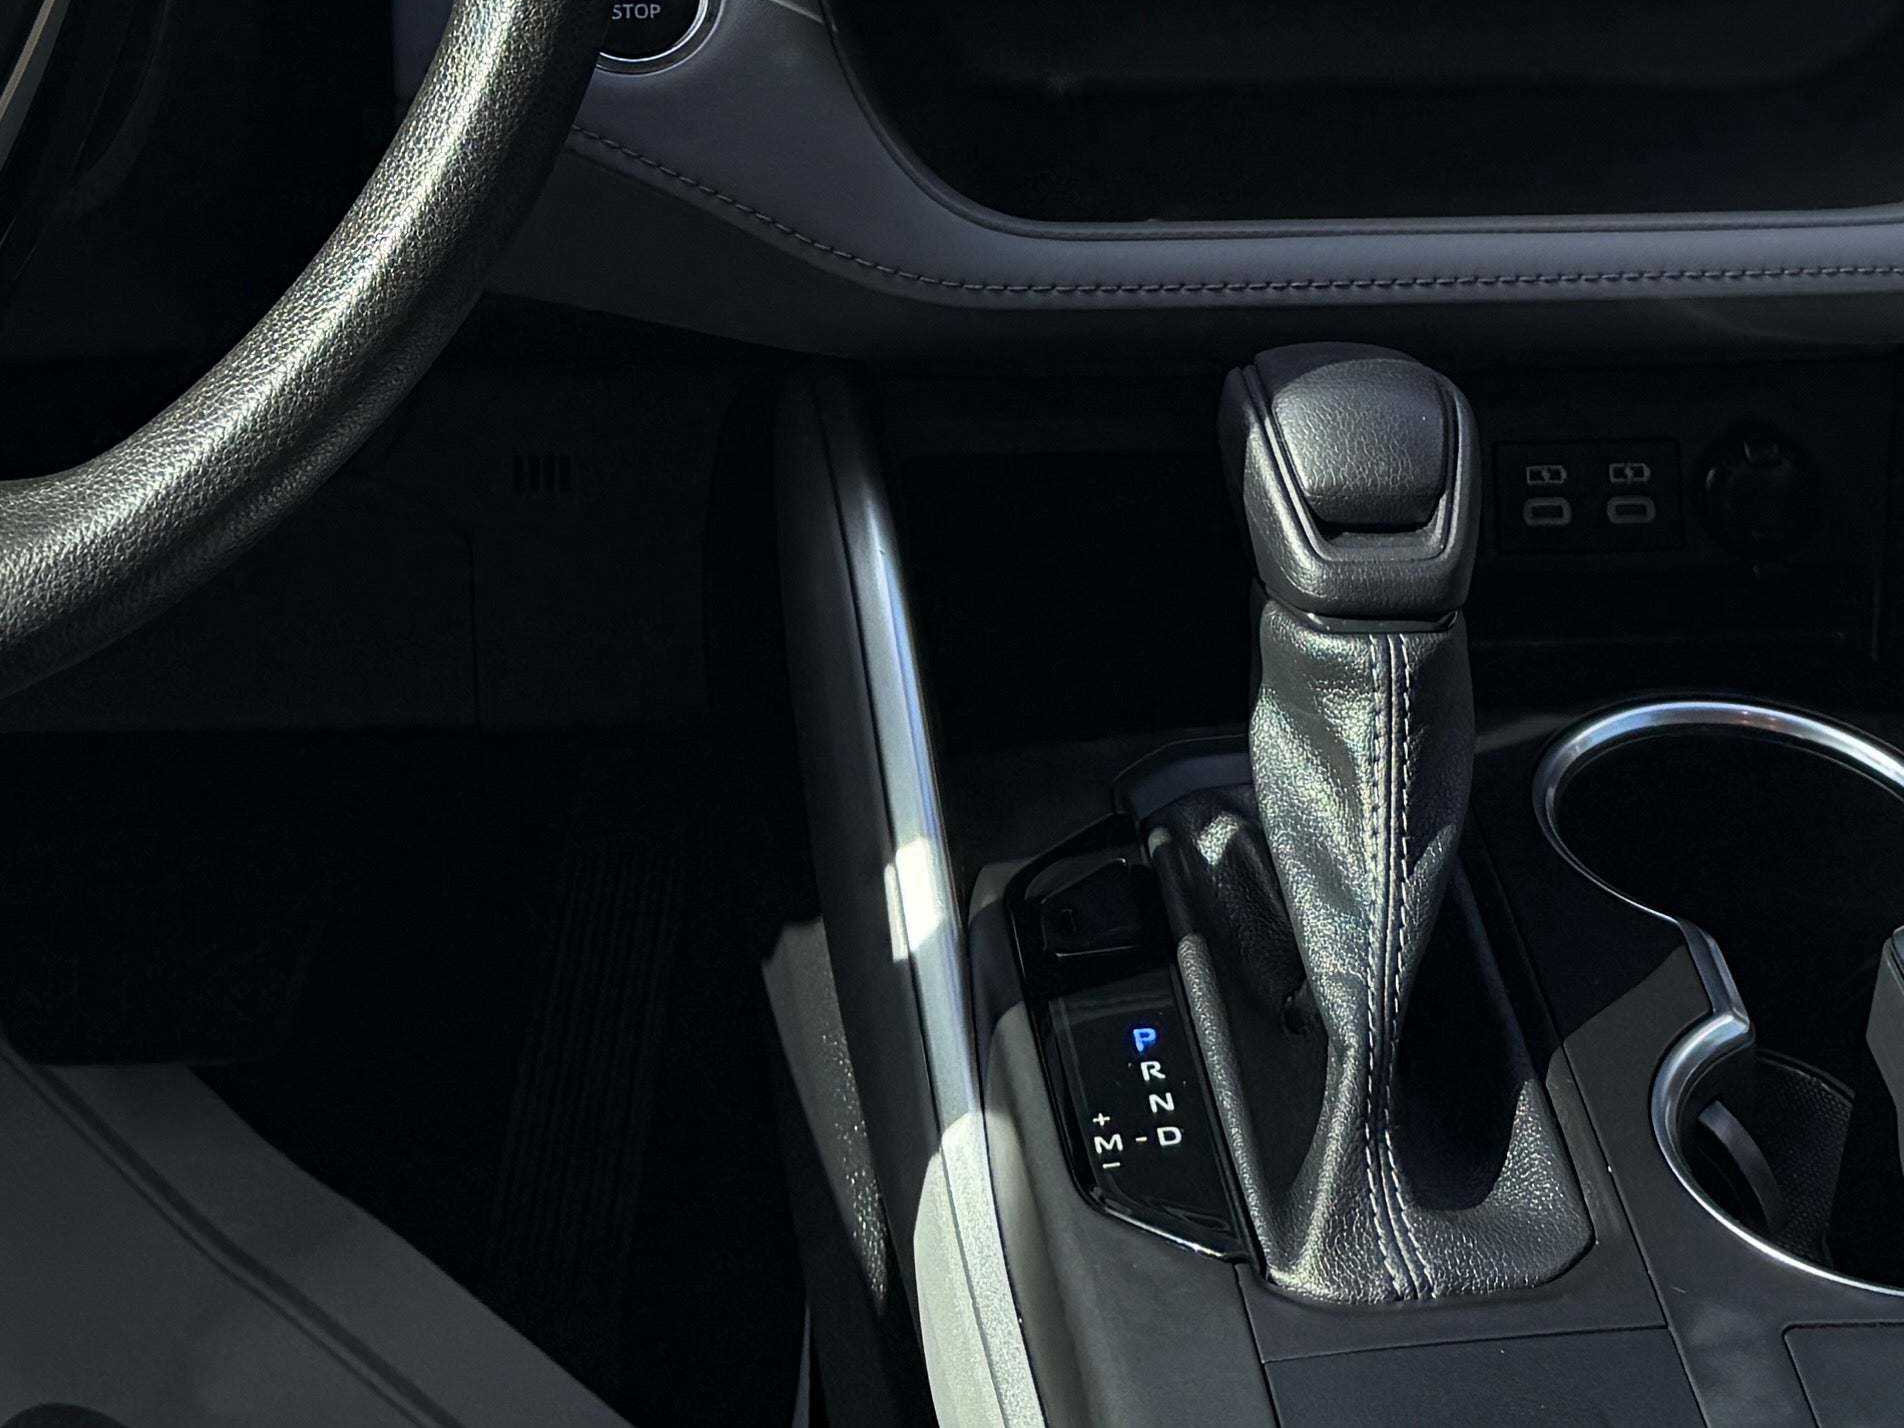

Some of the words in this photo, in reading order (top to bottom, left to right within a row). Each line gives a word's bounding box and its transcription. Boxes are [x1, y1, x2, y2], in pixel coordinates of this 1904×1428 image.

[611, 3, 661, 20] STOP
[1133, 1028, 1157, 1052] P
[1140, 1060, 1166, 1081] R
[1148, 1092, 1175, 1113] N
[1094, 1133, 1124, 1154] M
[1156, 1126, 1183, 1146] D
